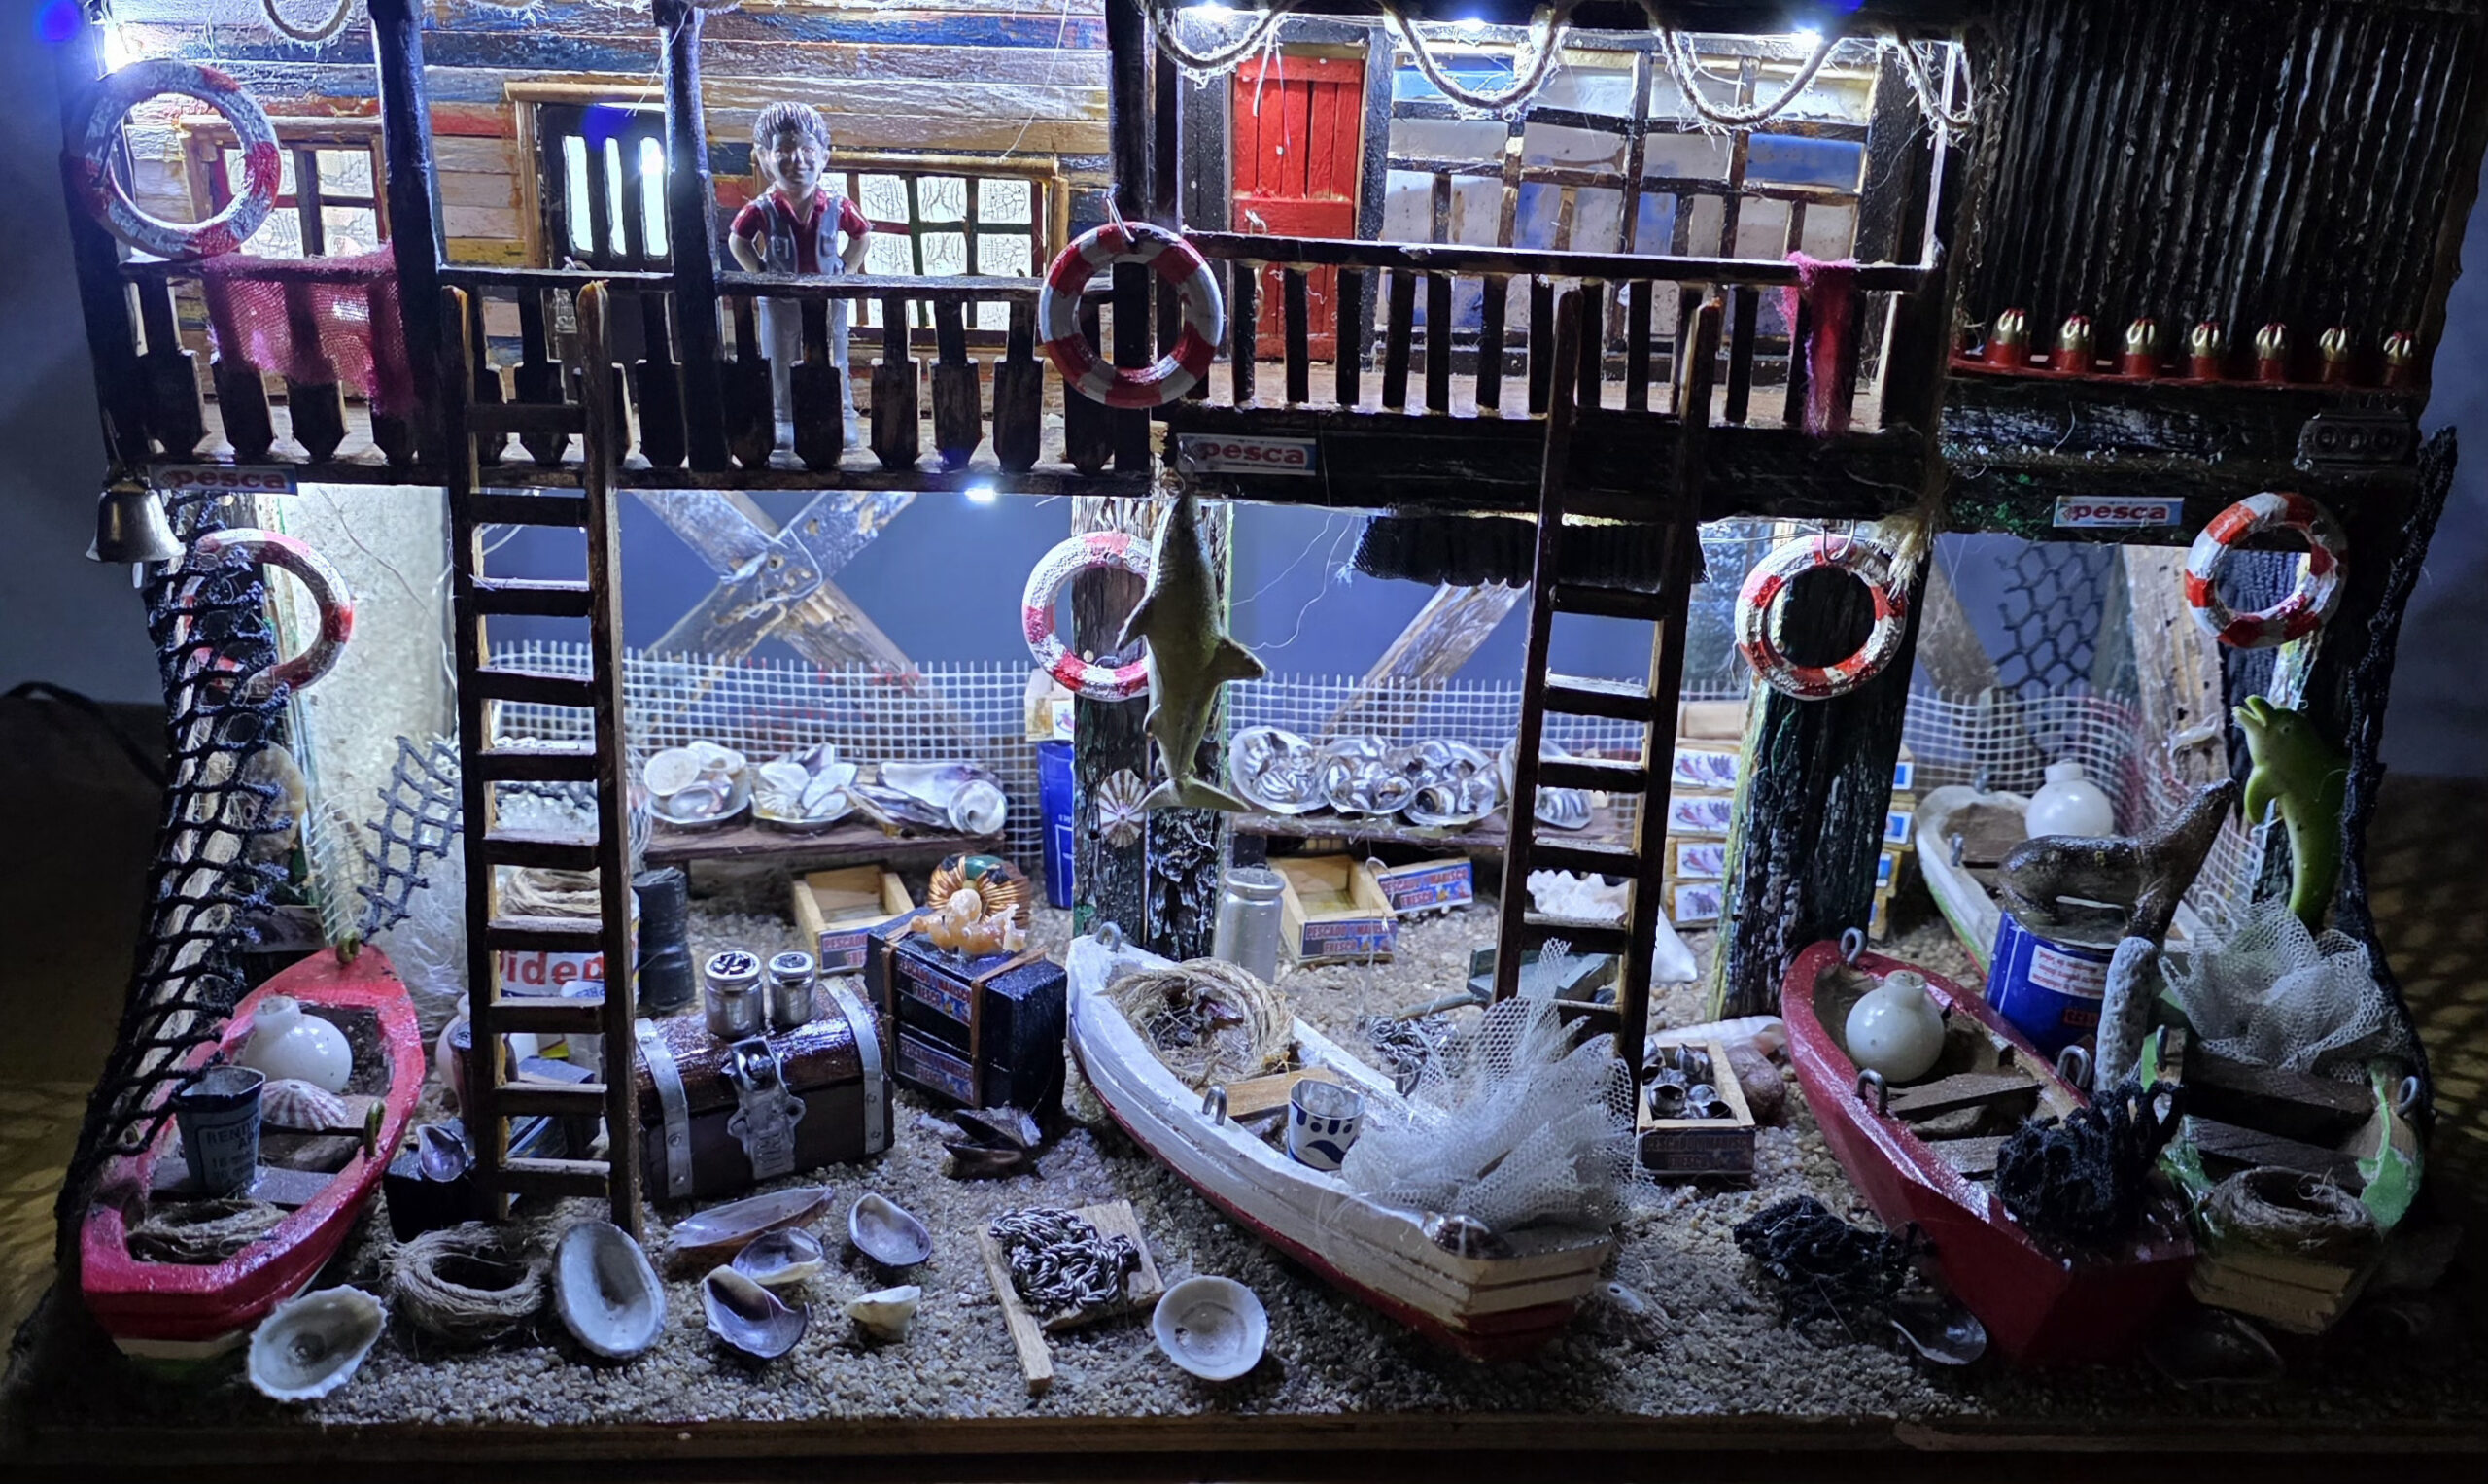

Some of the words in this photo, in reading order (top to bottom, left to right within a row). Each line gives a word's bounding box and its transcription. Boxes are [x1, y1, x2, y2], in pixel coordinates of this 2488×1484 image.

[1198, 442, 1304, 464] pesca
[166, 470, 285, 489] pesca
[2071, 505, 2166, 521] pesca
[1307, 925, 1347, 940] PESCADO
[1324, 940, 1357, 952] FRESCO
